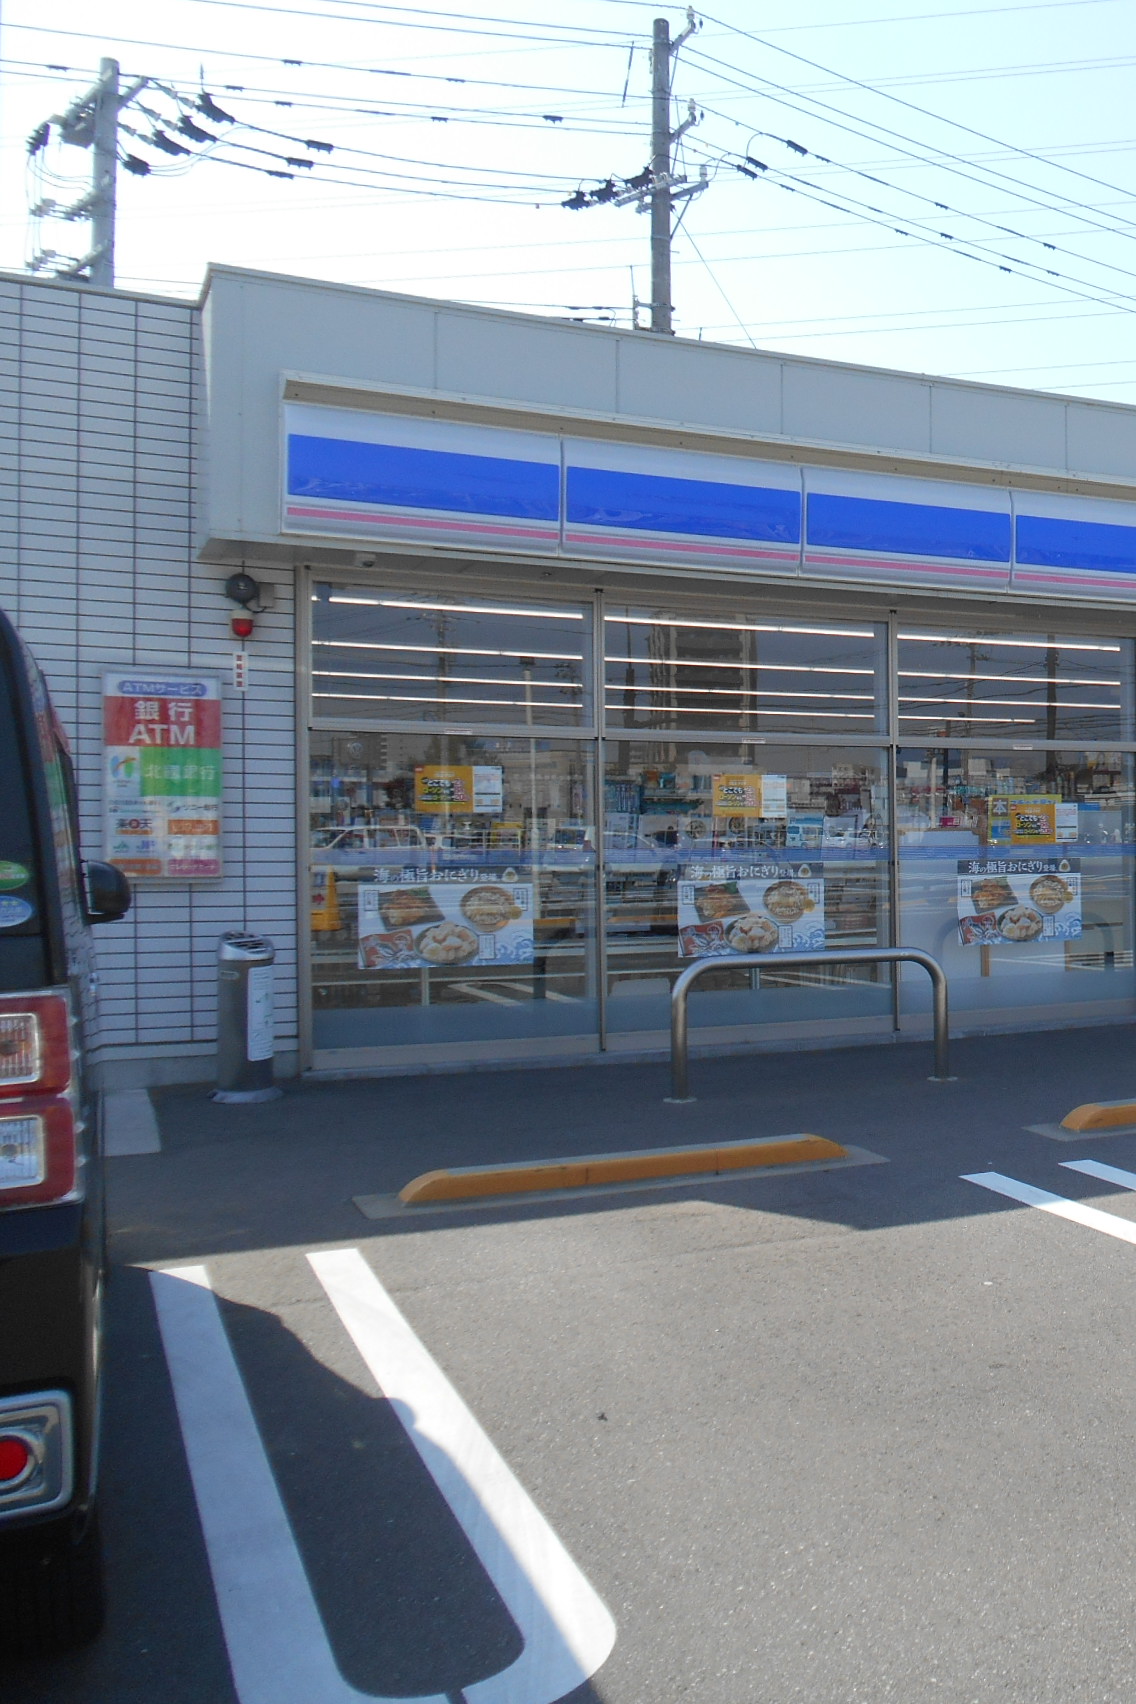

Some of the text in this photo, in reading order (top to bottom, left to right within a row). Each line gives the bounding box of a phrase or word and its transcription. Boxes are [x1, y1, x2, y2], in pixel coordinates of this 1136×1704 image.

[122, 682, 202, 695] ATMサービス
[134, 701, 194, 721] 銀行
[128, 723, 196, 745] ATM
[993, 800, 1007, 815] 本
